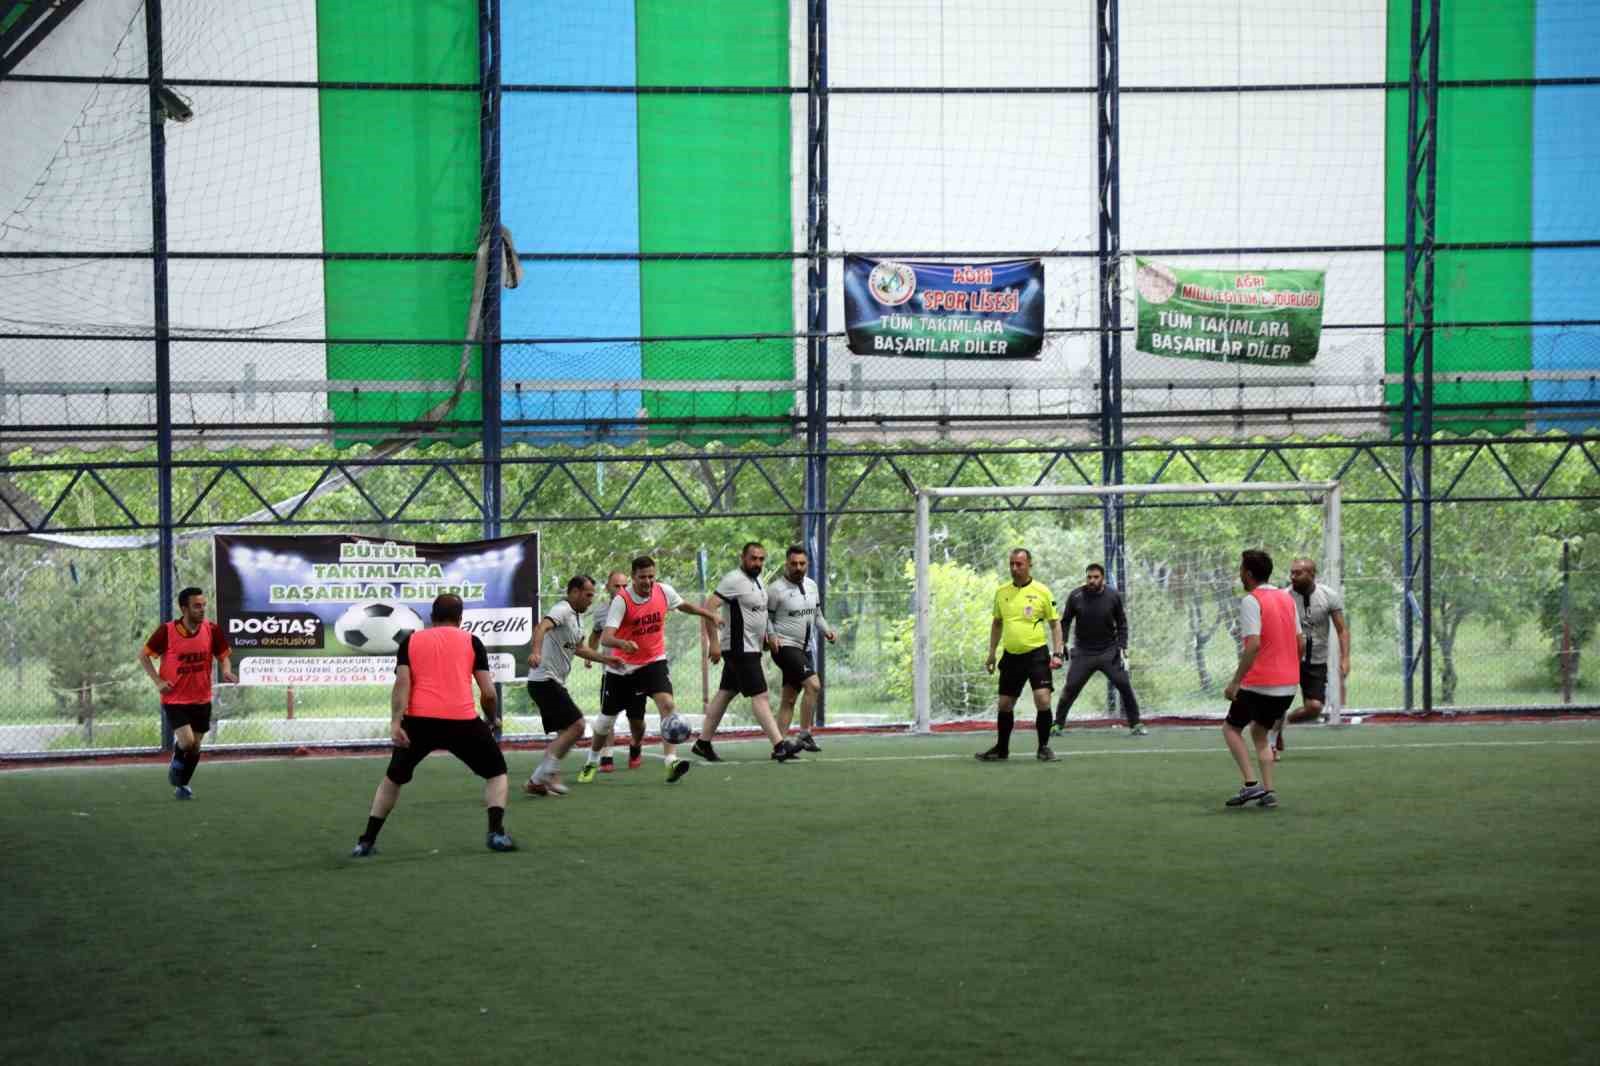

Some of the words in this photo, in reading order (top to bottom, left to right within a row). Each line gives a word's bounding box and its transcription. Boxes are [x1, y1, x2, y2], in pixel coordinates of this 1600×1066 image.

[923, 290, 966, 311] SPOR
[970, 288, 1020, 313] LİSESİ
[880, 314, 913, 331] TÜM
[919, 317, 1004, 334] TAKIMLARA
[1158, 309, 1193, 329] TÜM
[1199, 315, 1290, 338] TAKIMLARA
[874, 335, 960, 354] BAŞARILAR
[964, 337, 1009, 355] DİLER
[1152, 332, 1243, 356] BAŞARILAR
[1246, 339, 1292, 359] DİLER
[340, 541, 416, 561] BÜTÜN
[313, 564, 444, 581] TAKIMLARA
[271, 585, 396, 604] BAŞARILAR
[402, 581, 485, 601] DİLERİZ
[229, 616, 317, 637] DOĞTAŞ
[461, 617, 529, 637] arçelik
[261, 636, 317, 646] exclusive
